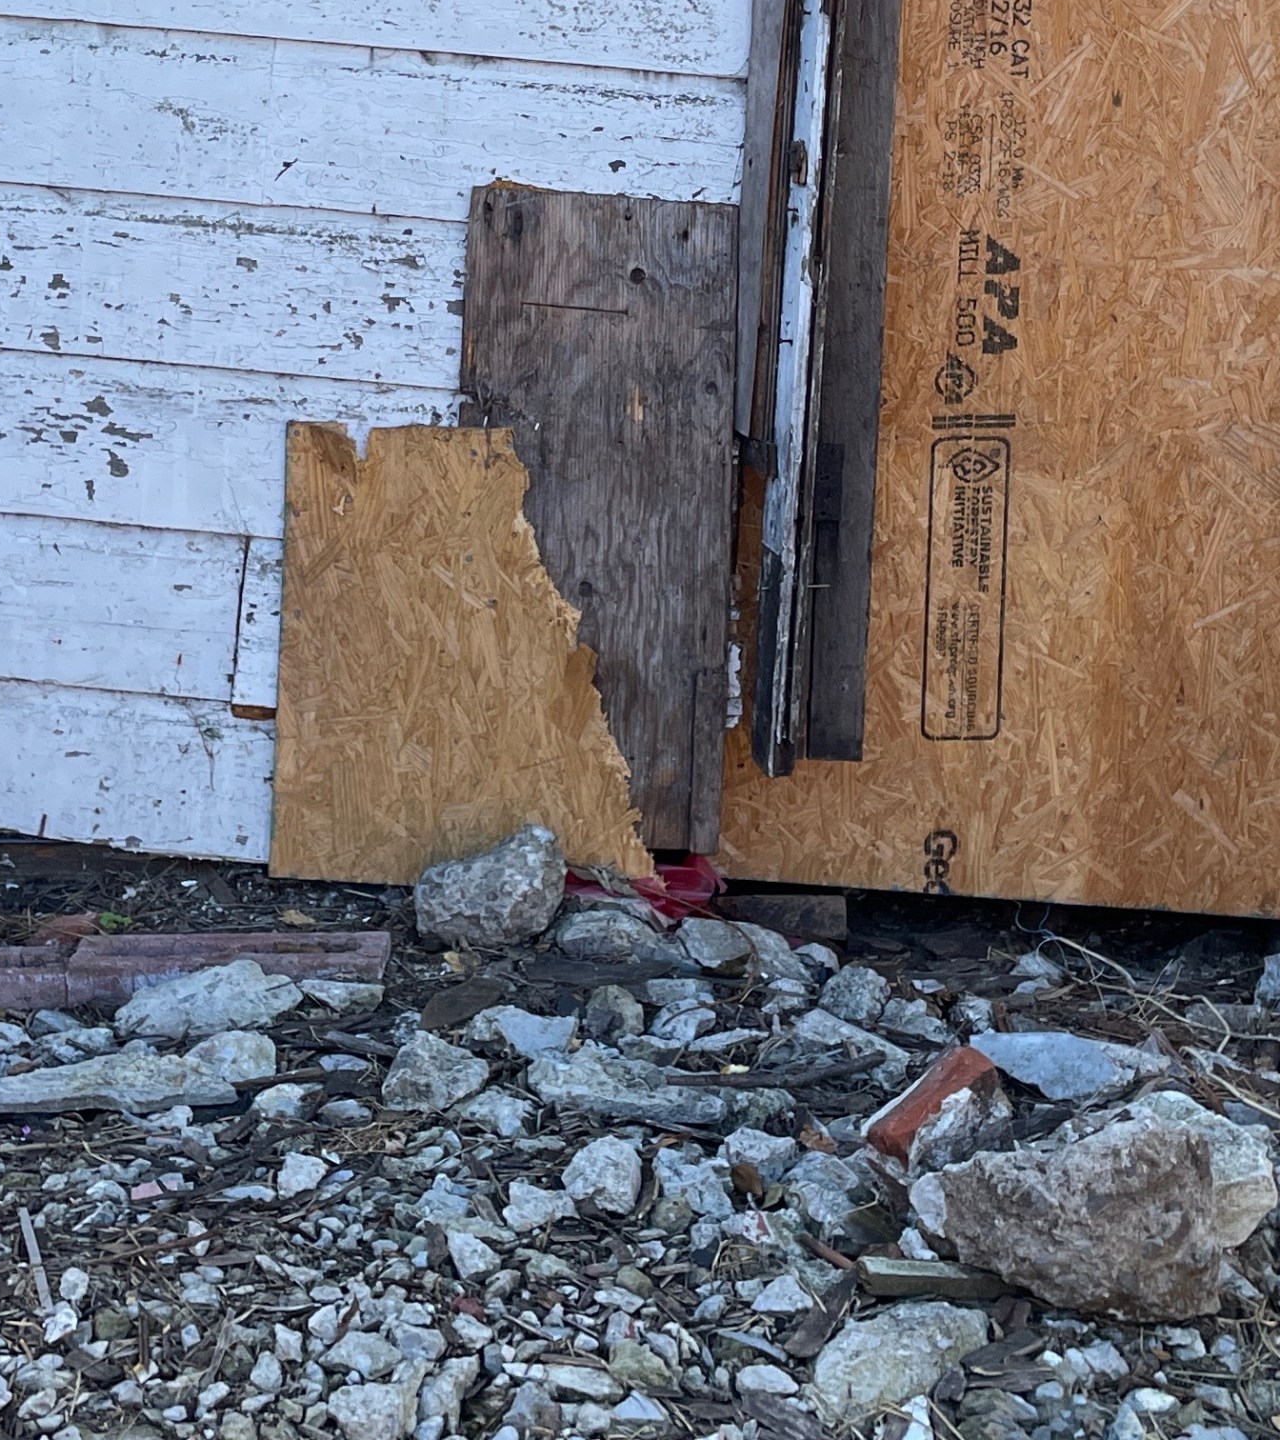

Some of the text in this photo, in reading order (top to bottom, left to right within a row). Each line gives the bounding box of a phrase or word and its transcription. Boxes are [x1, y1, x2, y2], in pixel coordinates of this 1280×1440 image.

[1010, 40, 1030, 79] CAT
[942, 121, 957, 191] PS 2-18
[970, 114, 983, 145] CSA
[955, 229, 980, 347] MILL 500
[982, 234, 1021, 355] APA
[952, 486, 966, 568] INITIATIVE
[978, 486, 993, 593] SUSTAINABLE
